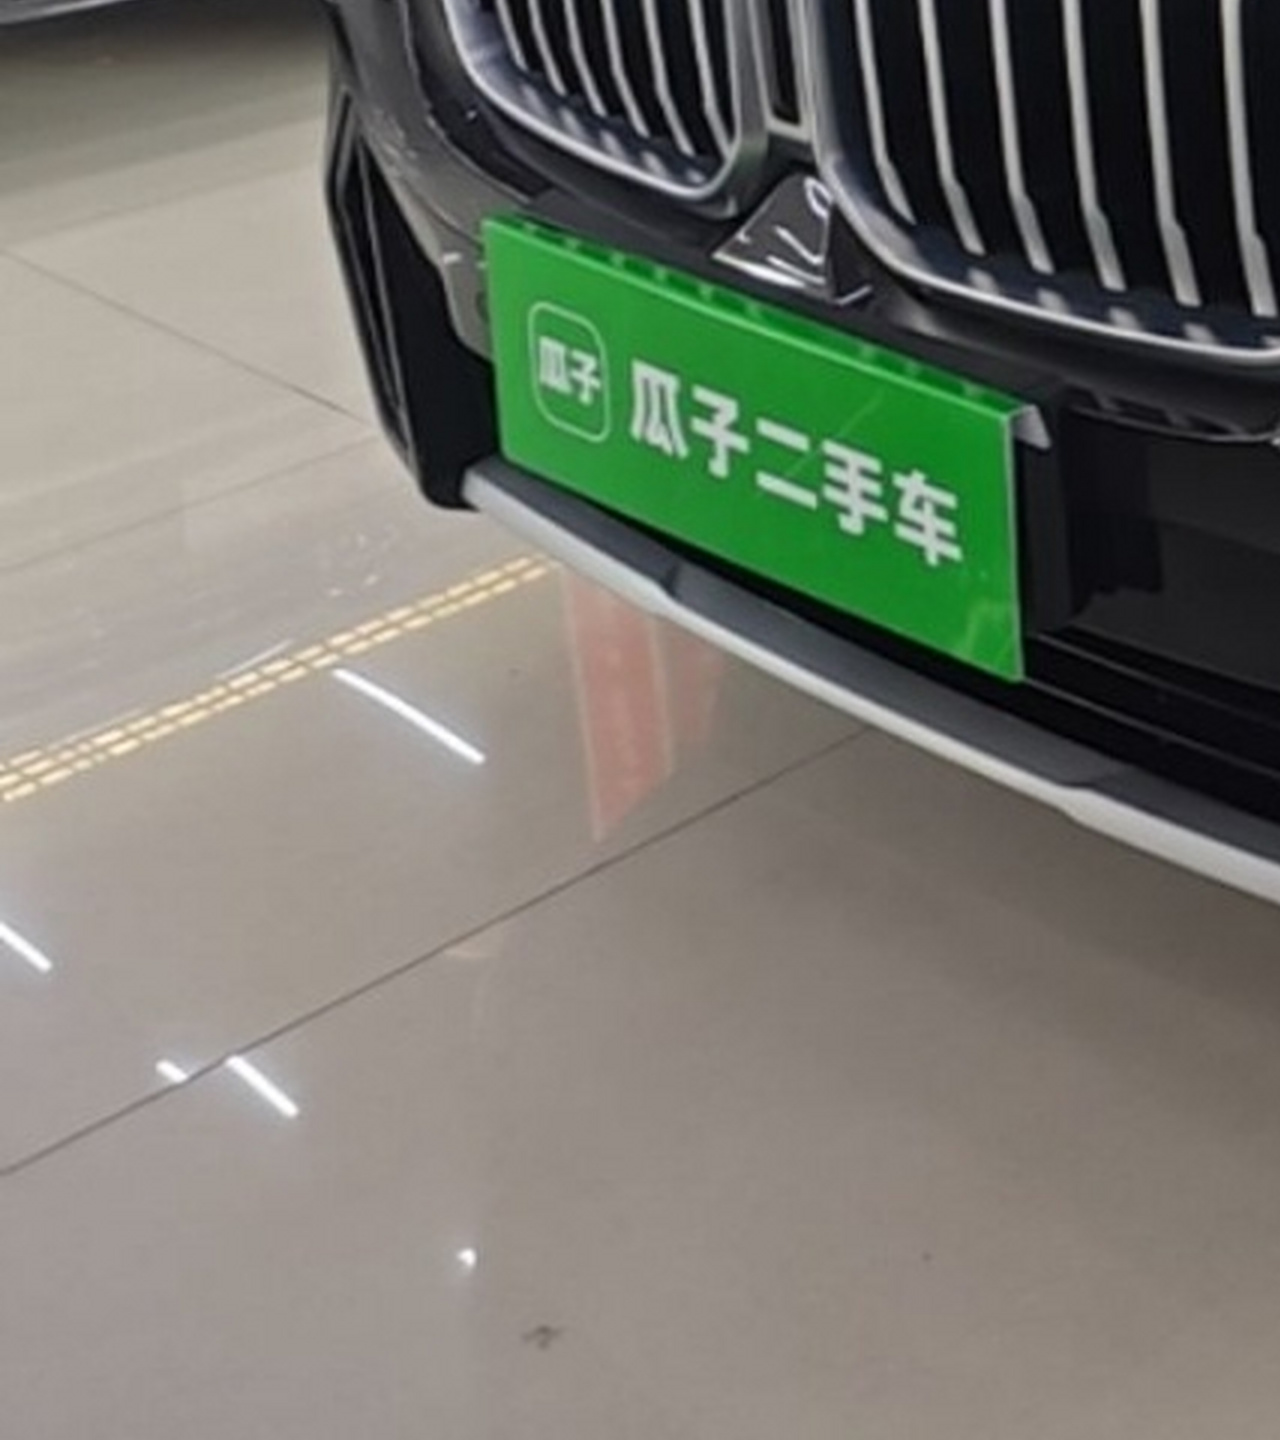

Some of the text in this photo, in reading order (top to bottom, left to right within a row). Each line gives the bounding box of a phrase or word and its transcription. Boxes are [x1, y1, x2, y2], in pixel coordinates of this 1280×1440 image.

[538, 336, 603, 406] 瓜子
[628, 357, 964, 567] 瓜子二手车
